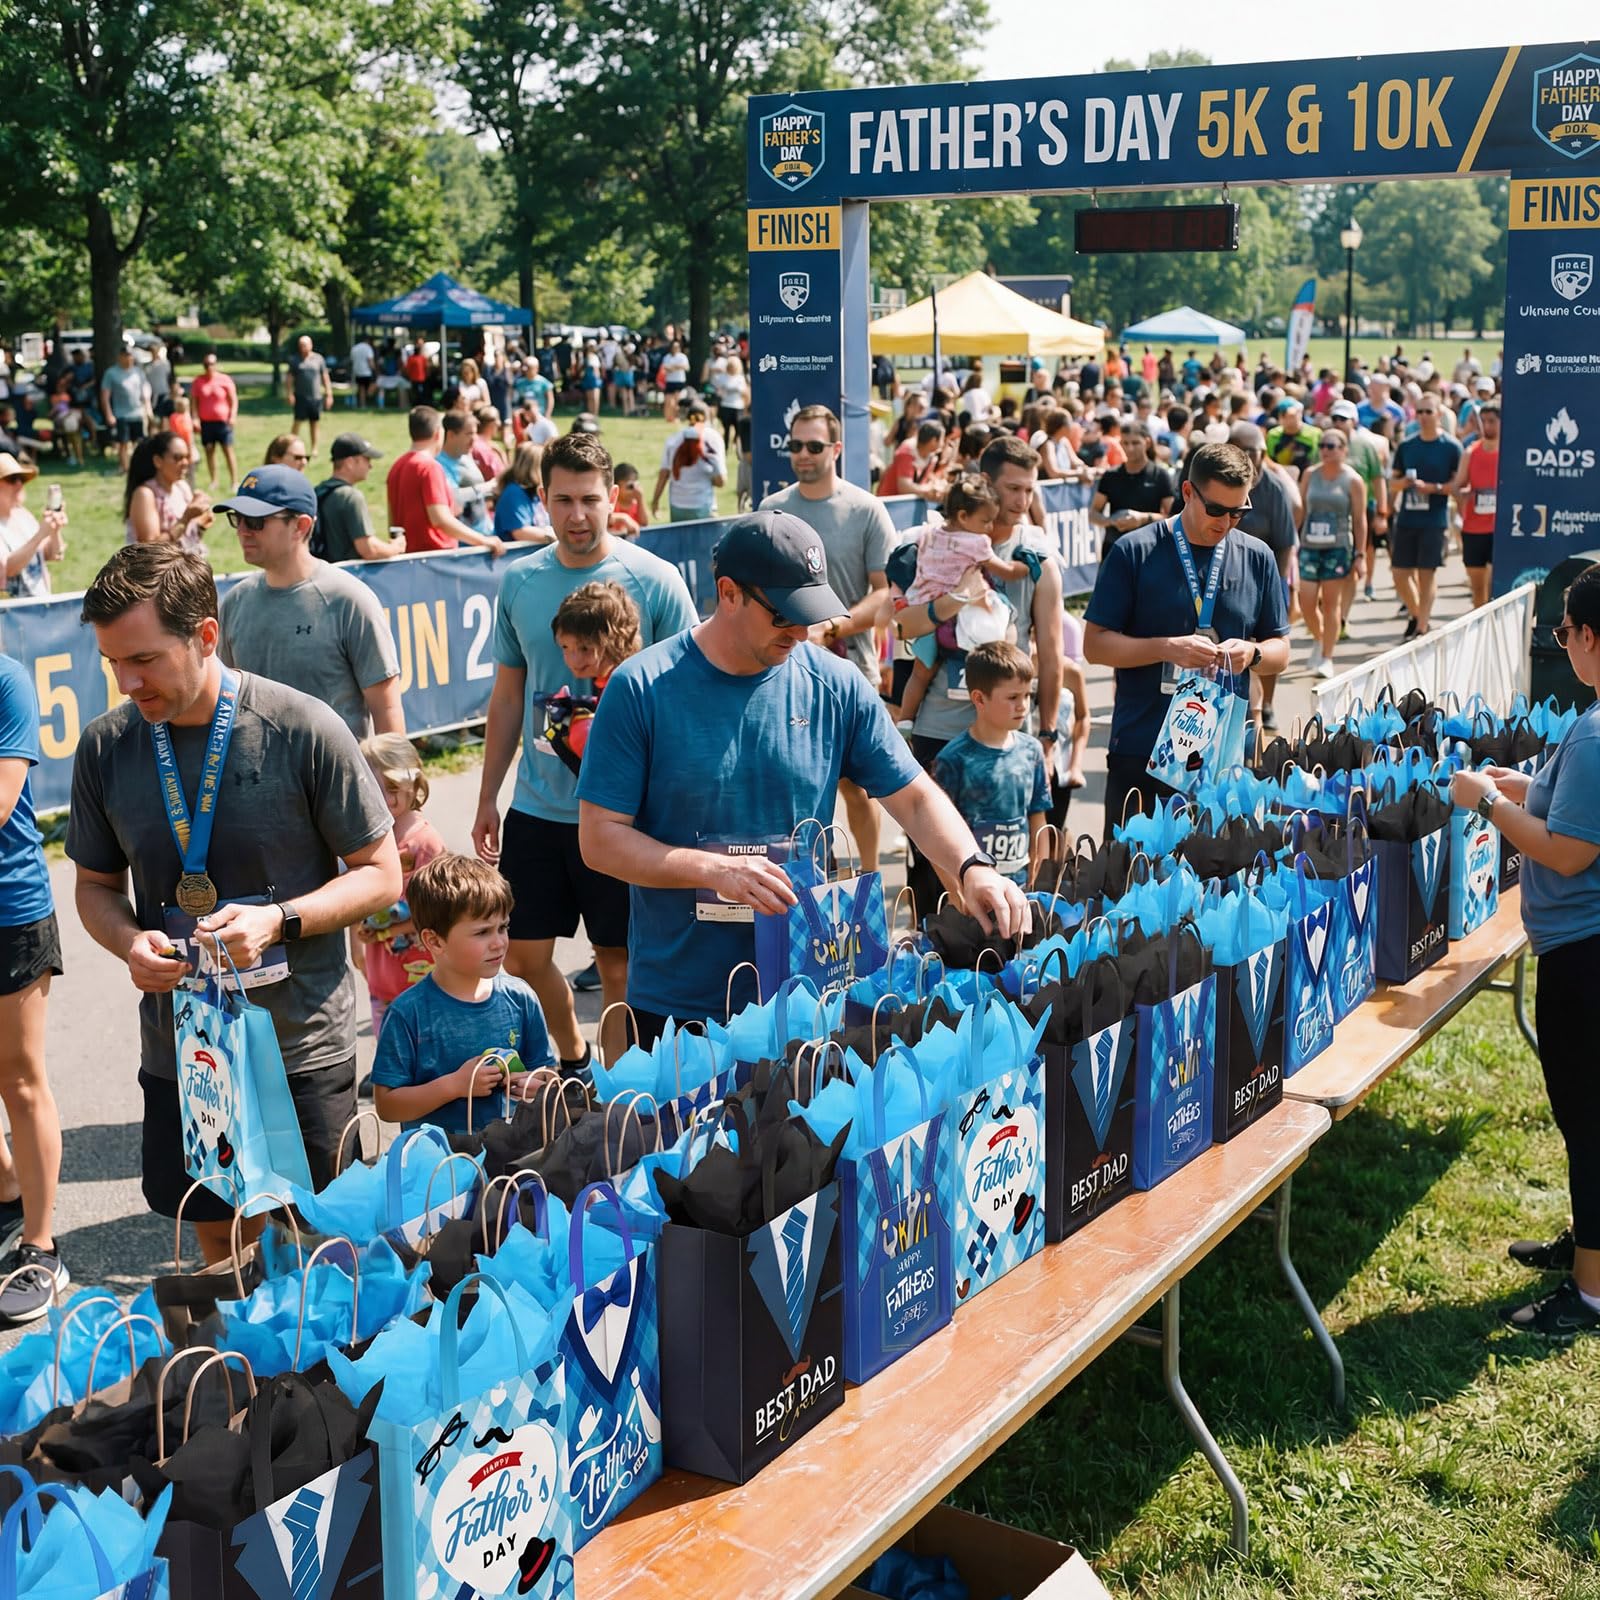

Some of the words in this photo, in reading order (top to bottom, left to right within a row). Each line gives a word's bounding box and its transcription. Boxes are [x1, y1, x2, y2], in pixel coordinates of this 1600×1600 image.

[1540, 86, 1600, 105] FATHER
[1562, 103, 1594, 122] DAY
[764, 129, 821, 147] FATHER'S
[772, 115, 813, 131] HAPPY
[850, 100, 1069, 175] FATHER'S
[1084, 92, 1183, 163] DAY
[1197, 87, 1270, 159] 5K
[1286, 84, 1322, 155] &
[1347, 76, 1455, 151] 10K
[780, 145, 804, 161] DAY
[1524, 184, 1600, 222] FINIS
[758, 213, 830, 245] FINISH
[1525, 448, 1595, 468] DAD'S
[384, 600, 450, 696] UN
[1234, 1078, 1258, 1111] BEST
[1259, 1064, 1279, 1093] DAD
[972, 1136, 1033, 1203] Father's
[1071, 1169, 1100, 1207] BEST
[1102, 1152, 1128, 1187] DAD
[993, 1188, 1014, 1211] DAY
[755, 1382, 795, 1437] BEST
[800, 1355, 836, 1402] DAD
[482, 1455, 510, 1477] HAPPY
[445, 1464, 550, 1564] Father's
[483, 1533, 517, 1569] DAY
